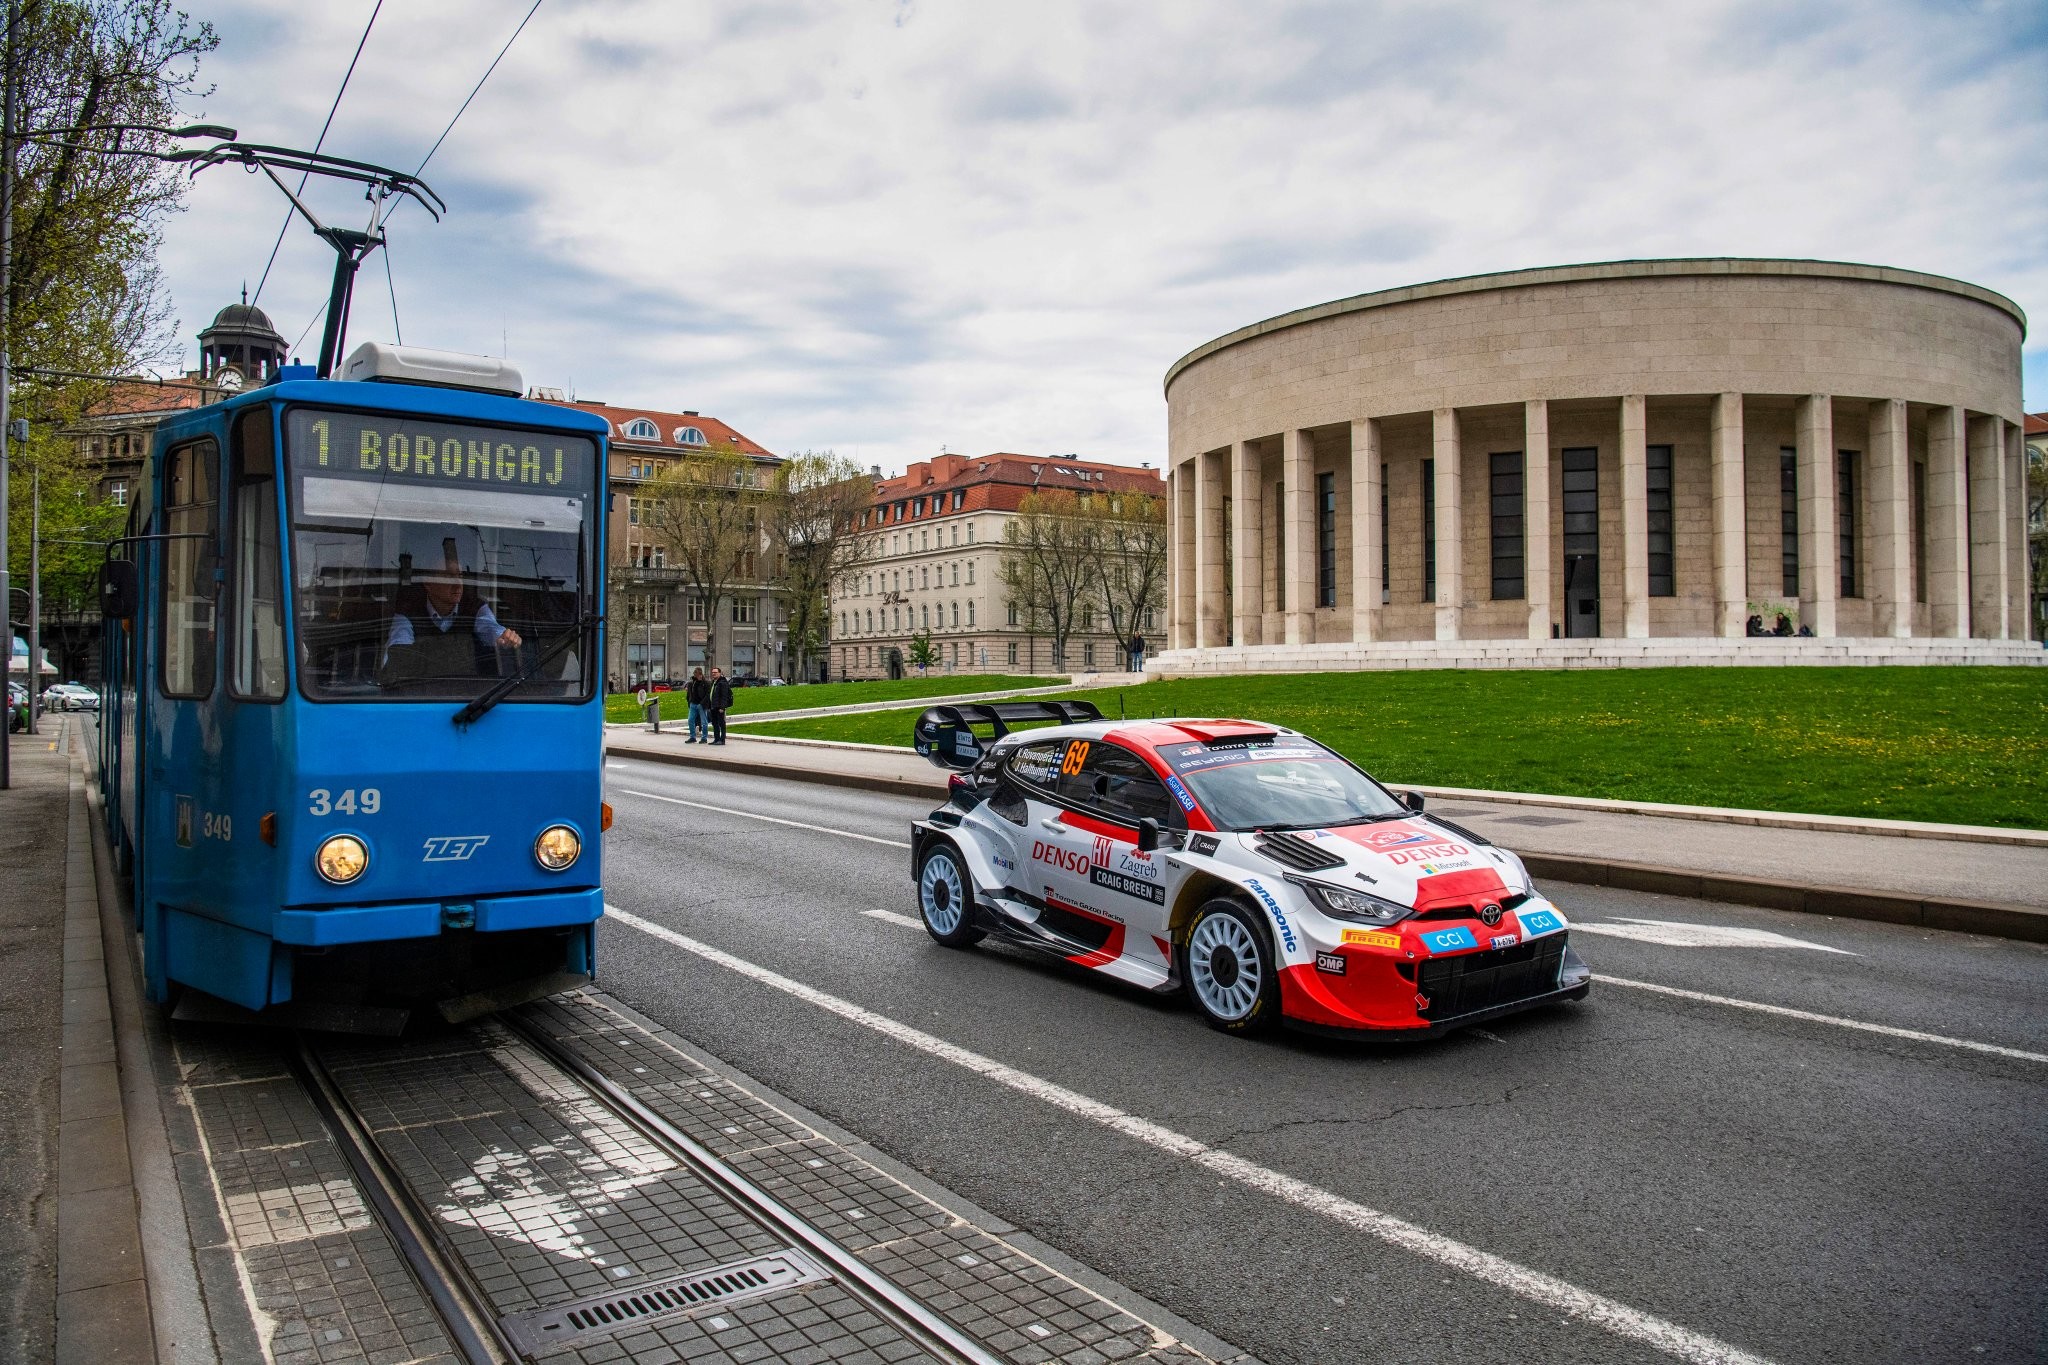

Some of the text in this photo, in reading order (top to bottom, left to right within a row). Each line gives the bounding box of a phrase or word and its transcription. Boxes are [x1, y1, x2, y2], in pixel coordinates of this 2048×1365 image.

[312, 419, 563, 485] 1 BORONGAJ
[1062, 741, 1090, 776] 69
[1180, 753, 1246, 769] BEYOND
[1203, 743, 1246, 752] TOYOTA
[309, 788, 381, 816] 349
[204, 812, 232, 841] 349
[422, 835, 491, 862] ZET
[1032, 841, 1090, 875] DENSO
[1387, 844, 1469, 865] DENSO
[1120, 854, 1157, 878] Zagreb
[1434, 859, 1472, 871] Microsoft
[1096, 870, 1122, 889] CRAIG
[1123, 880, 1152, 899] BREEN
[1242, 878, 1297, 954] Panasonic
[1345, 930, 1396, 946] PIRELLI
[1317, 956, 1344, 971] OMP
